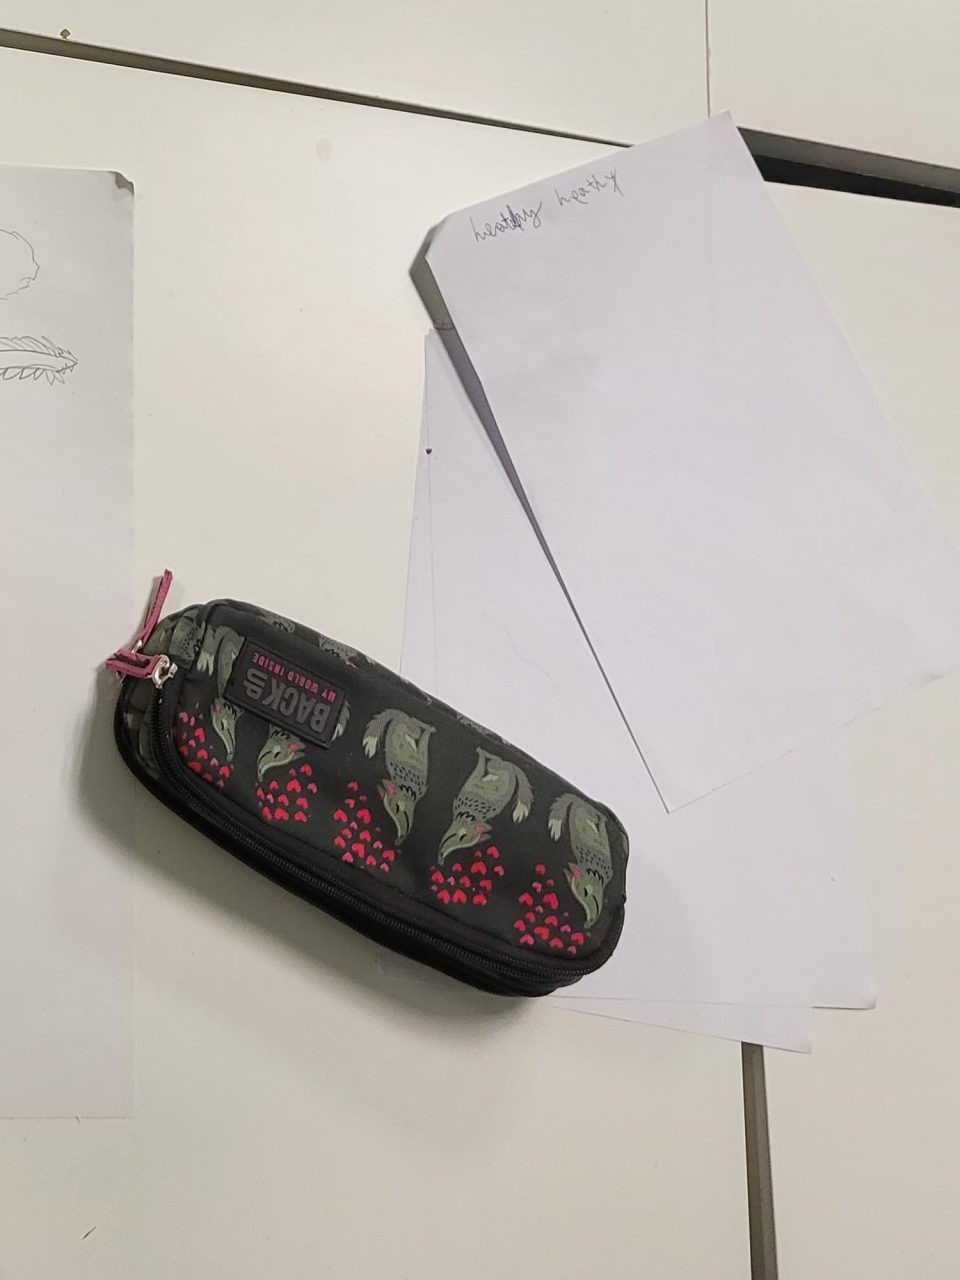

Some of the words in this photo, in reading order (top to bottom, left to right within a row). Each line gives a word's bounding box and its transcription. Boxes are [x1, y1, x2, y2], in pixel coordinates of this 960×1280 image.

[251, 652, 285, 676] INSIDE
[287, 671, 319, 694] WORLD
[262, 677, 331, 734] BACK
[321, 688, 336, 703] MY
